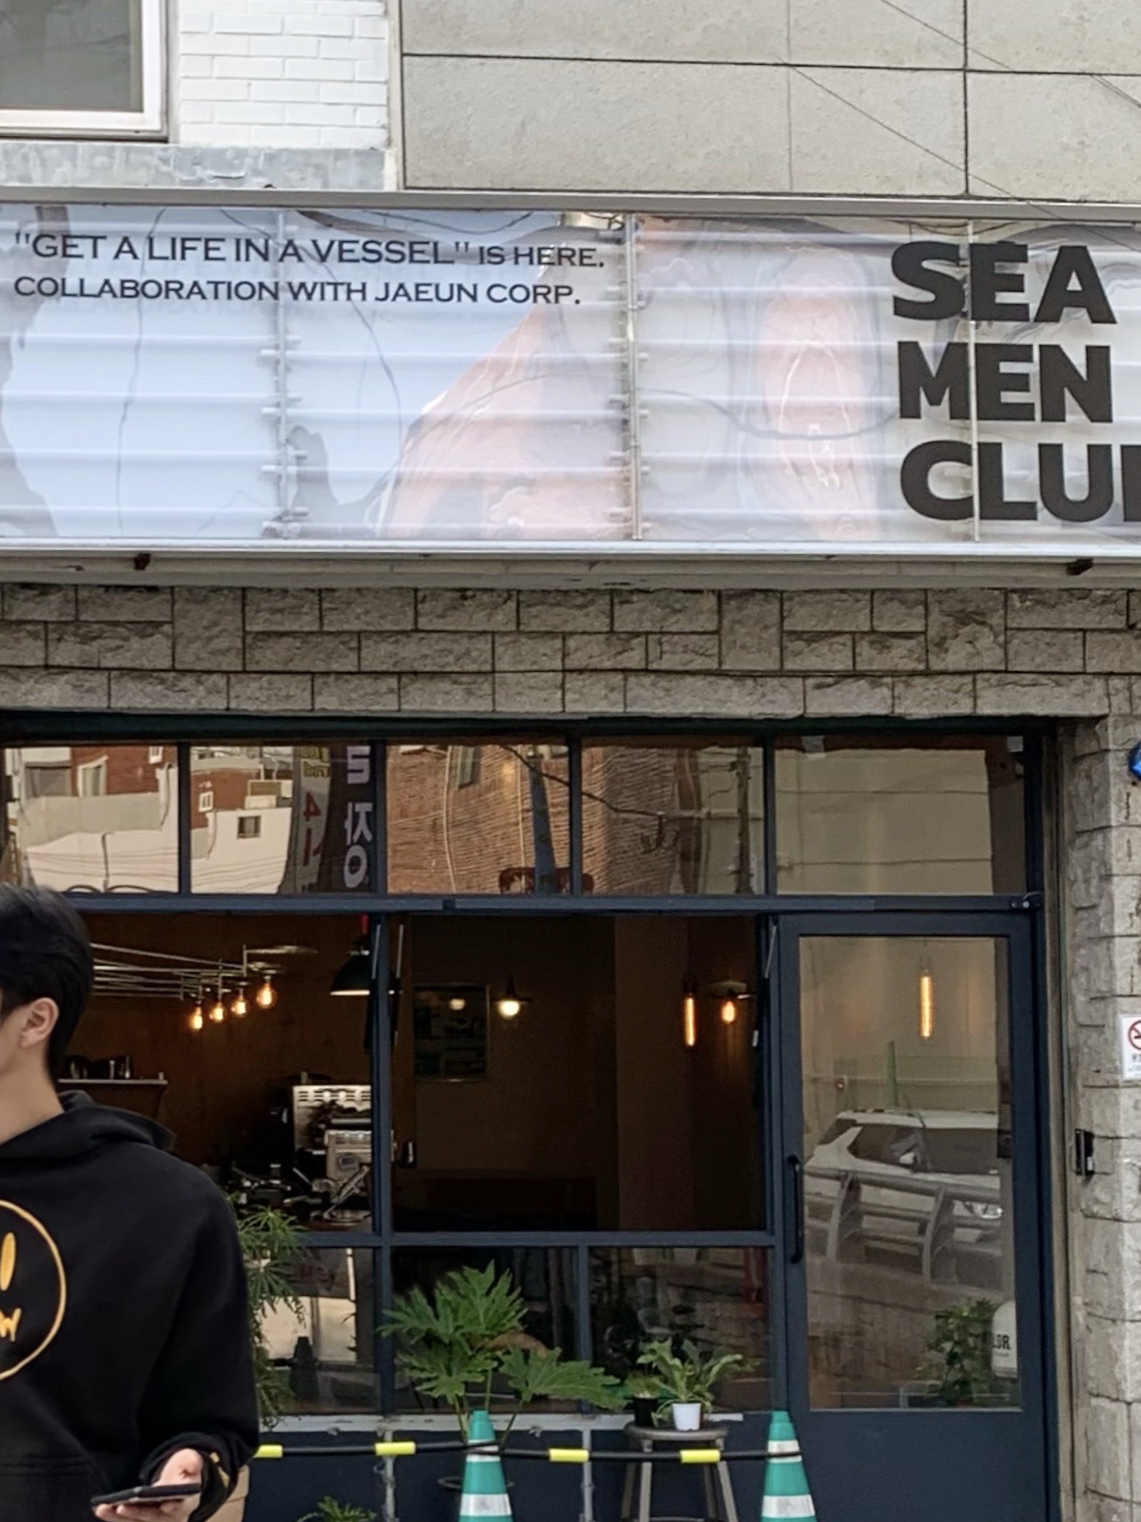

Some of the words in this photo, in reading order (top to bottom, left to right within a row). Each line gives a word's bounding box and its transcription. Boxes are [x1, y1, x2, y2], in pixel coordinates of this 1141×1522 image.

[14, 276, 279, 301] COLLABORATION
[288, 281, 367, 303] WITH
[374, 282, 478, 304] JAEUN
[486, 284, 582, 306] CORP.
[113, 236, 140, 260] A
[148, 237, 227, 261] LIFE
[235, 237, 270, 262] IN
[279, 239, 305, 263] A
[479, 245, 505, 265] IS
[513, 247, 605, 268] HERE.
[891, 240, 1118, 324] SEA
[897, 340, 1114, 423] MEN
[900, 439, 1141, 523] CLU
